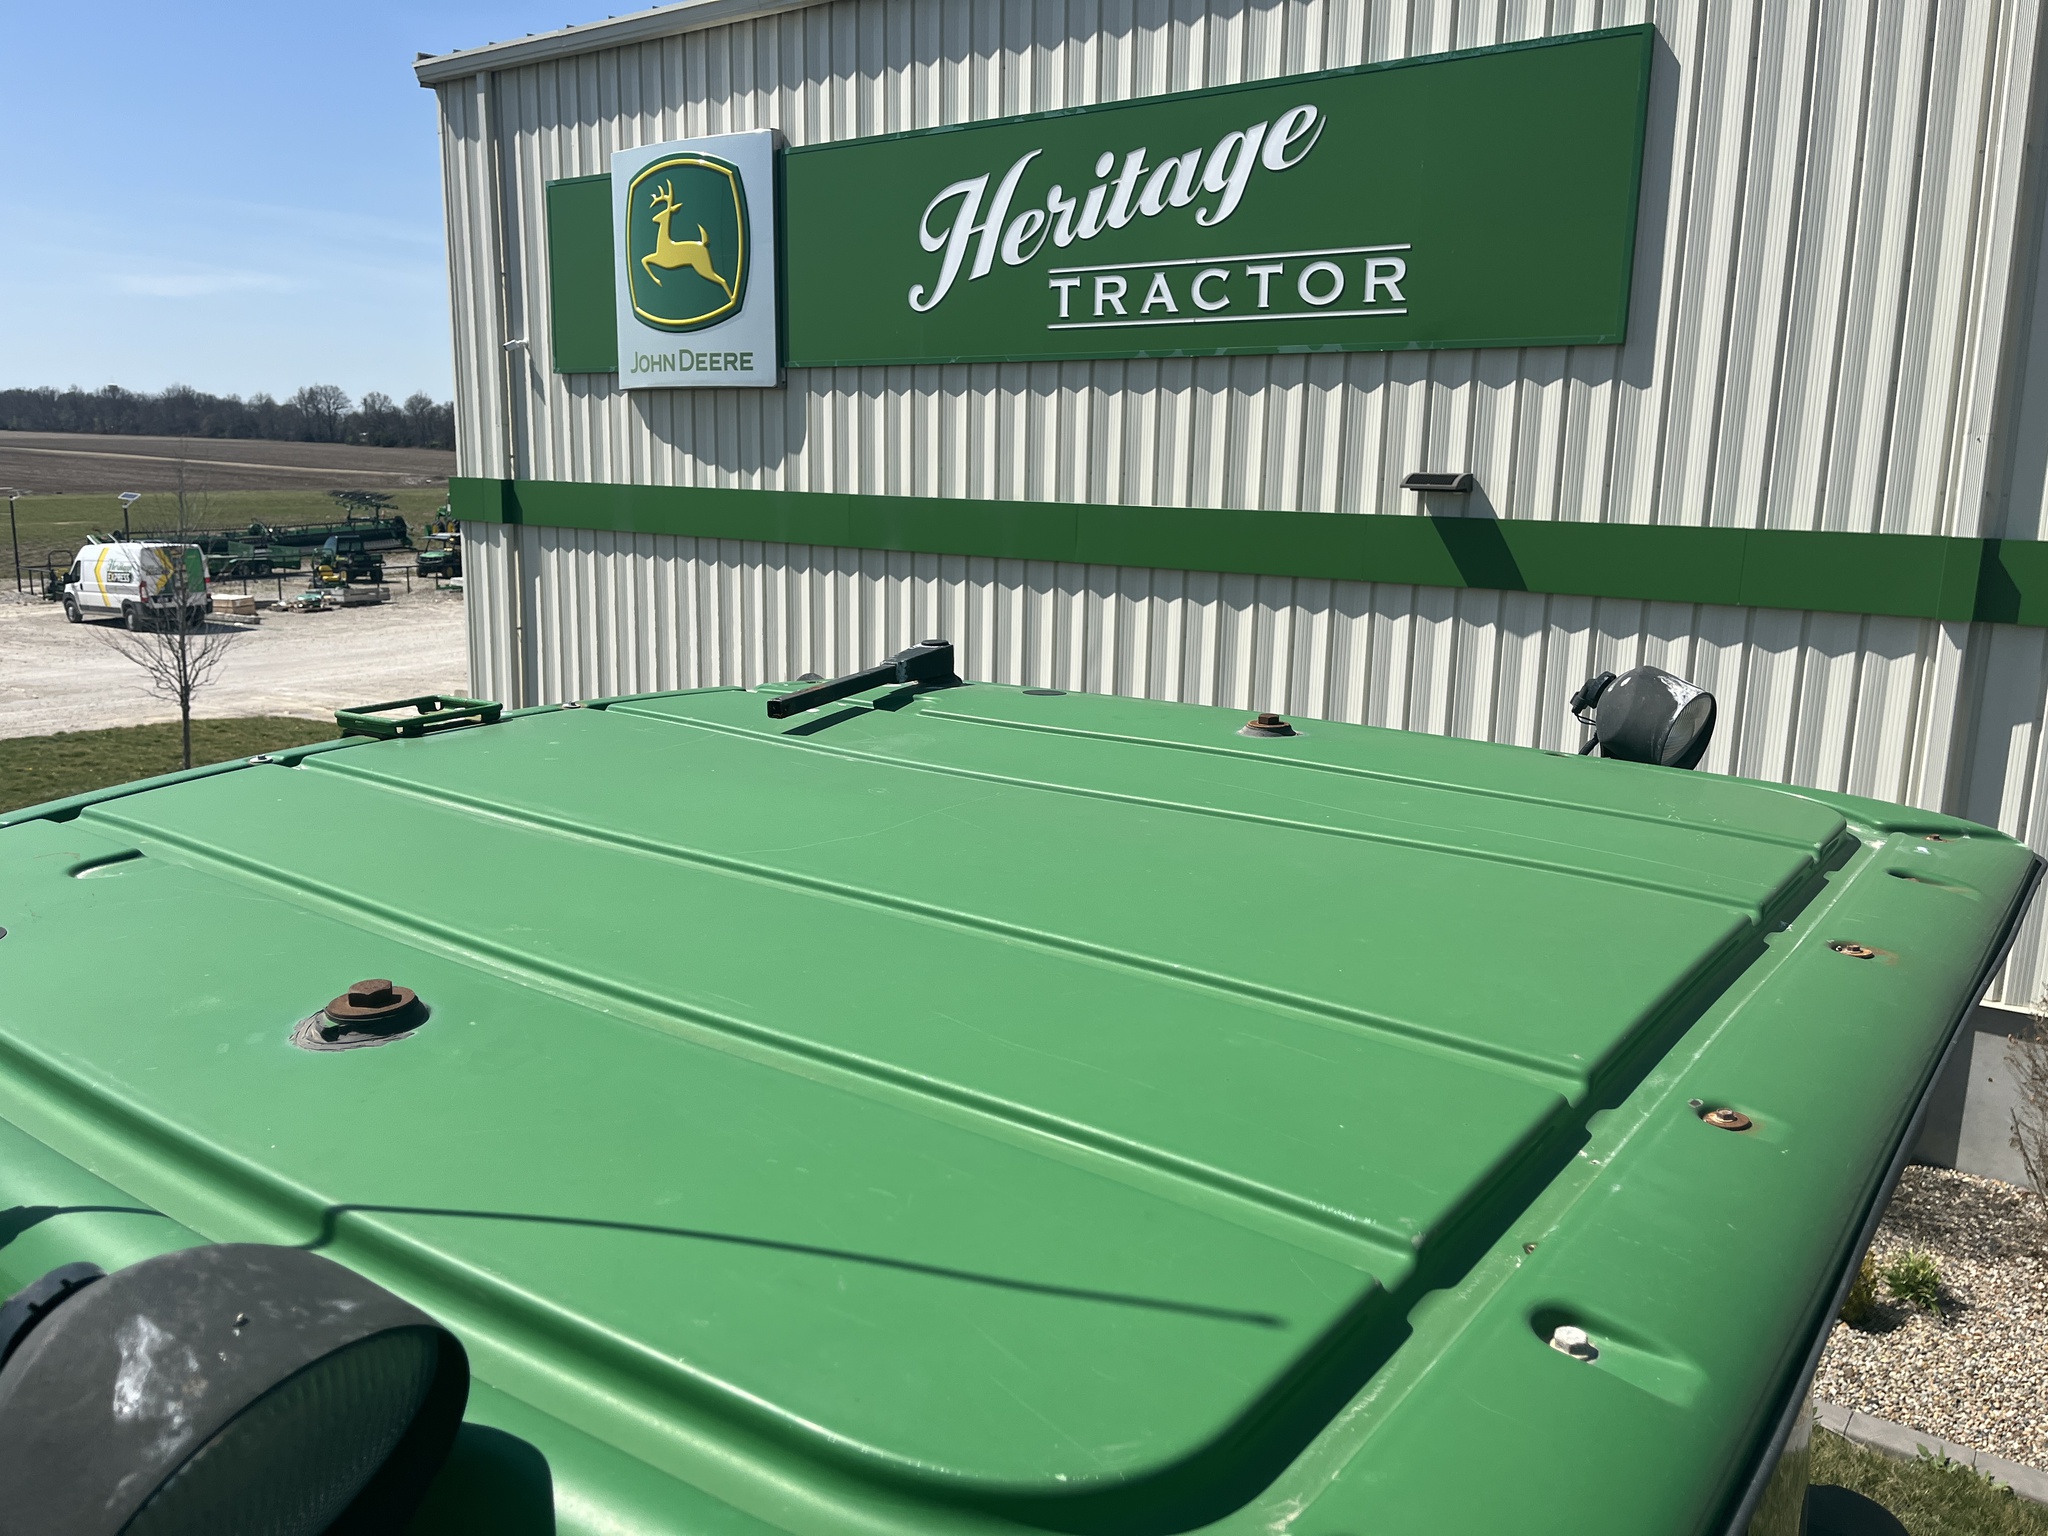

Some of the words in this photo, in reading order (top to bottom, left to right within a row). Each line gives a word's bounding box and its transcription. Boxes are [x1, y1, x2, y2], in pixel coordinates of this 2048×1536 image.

[908, 104, 1327, 312] Heritage
[1049, 256, 1407, 319] TRACTOR
[631, 351, 675, 374] JOHN
[679, 349, 753, 372] DEERE
